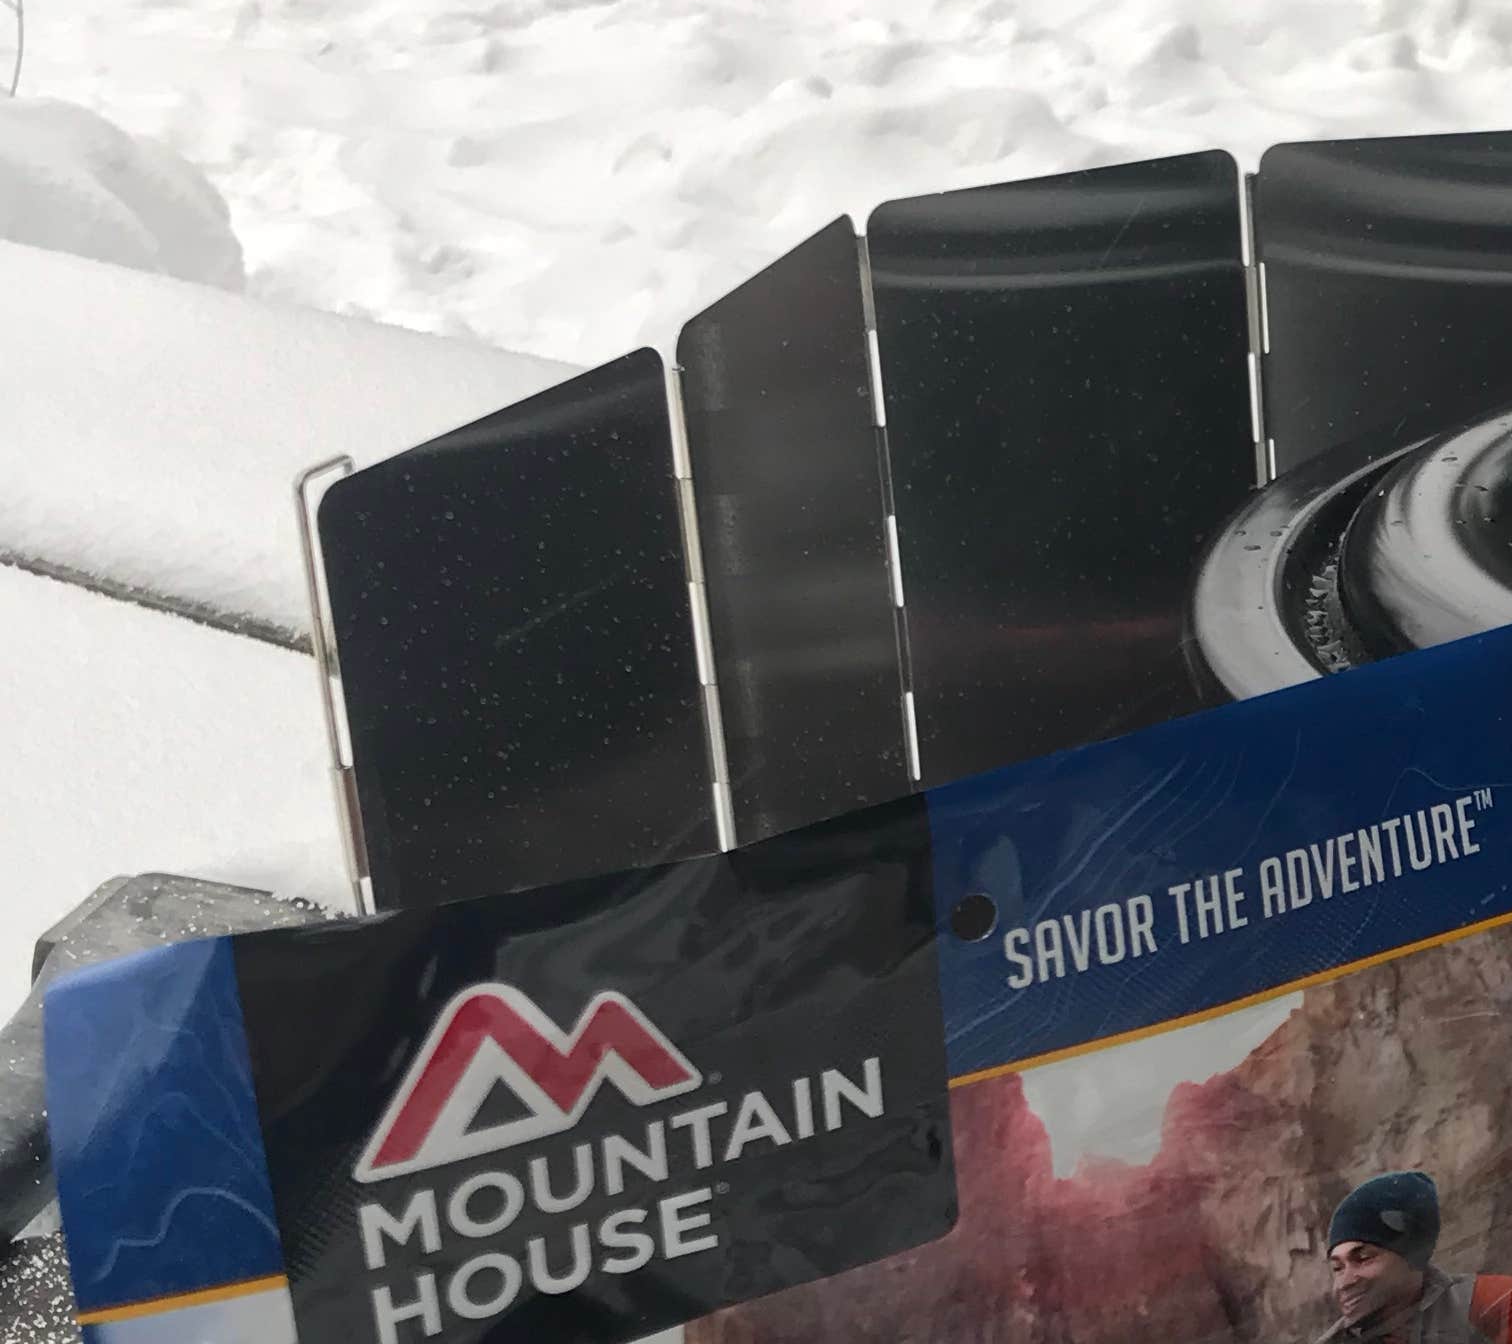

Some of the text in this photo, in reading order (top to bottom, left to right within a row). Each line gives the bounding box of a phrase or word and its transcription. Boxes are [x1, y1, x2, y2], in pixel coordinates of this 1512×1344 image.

[1003, 894, 1158, 990] SAVOR
[1168, 867, 1248, 945] THE
[358, 1056, 886, 1270] MOUNTAIN
